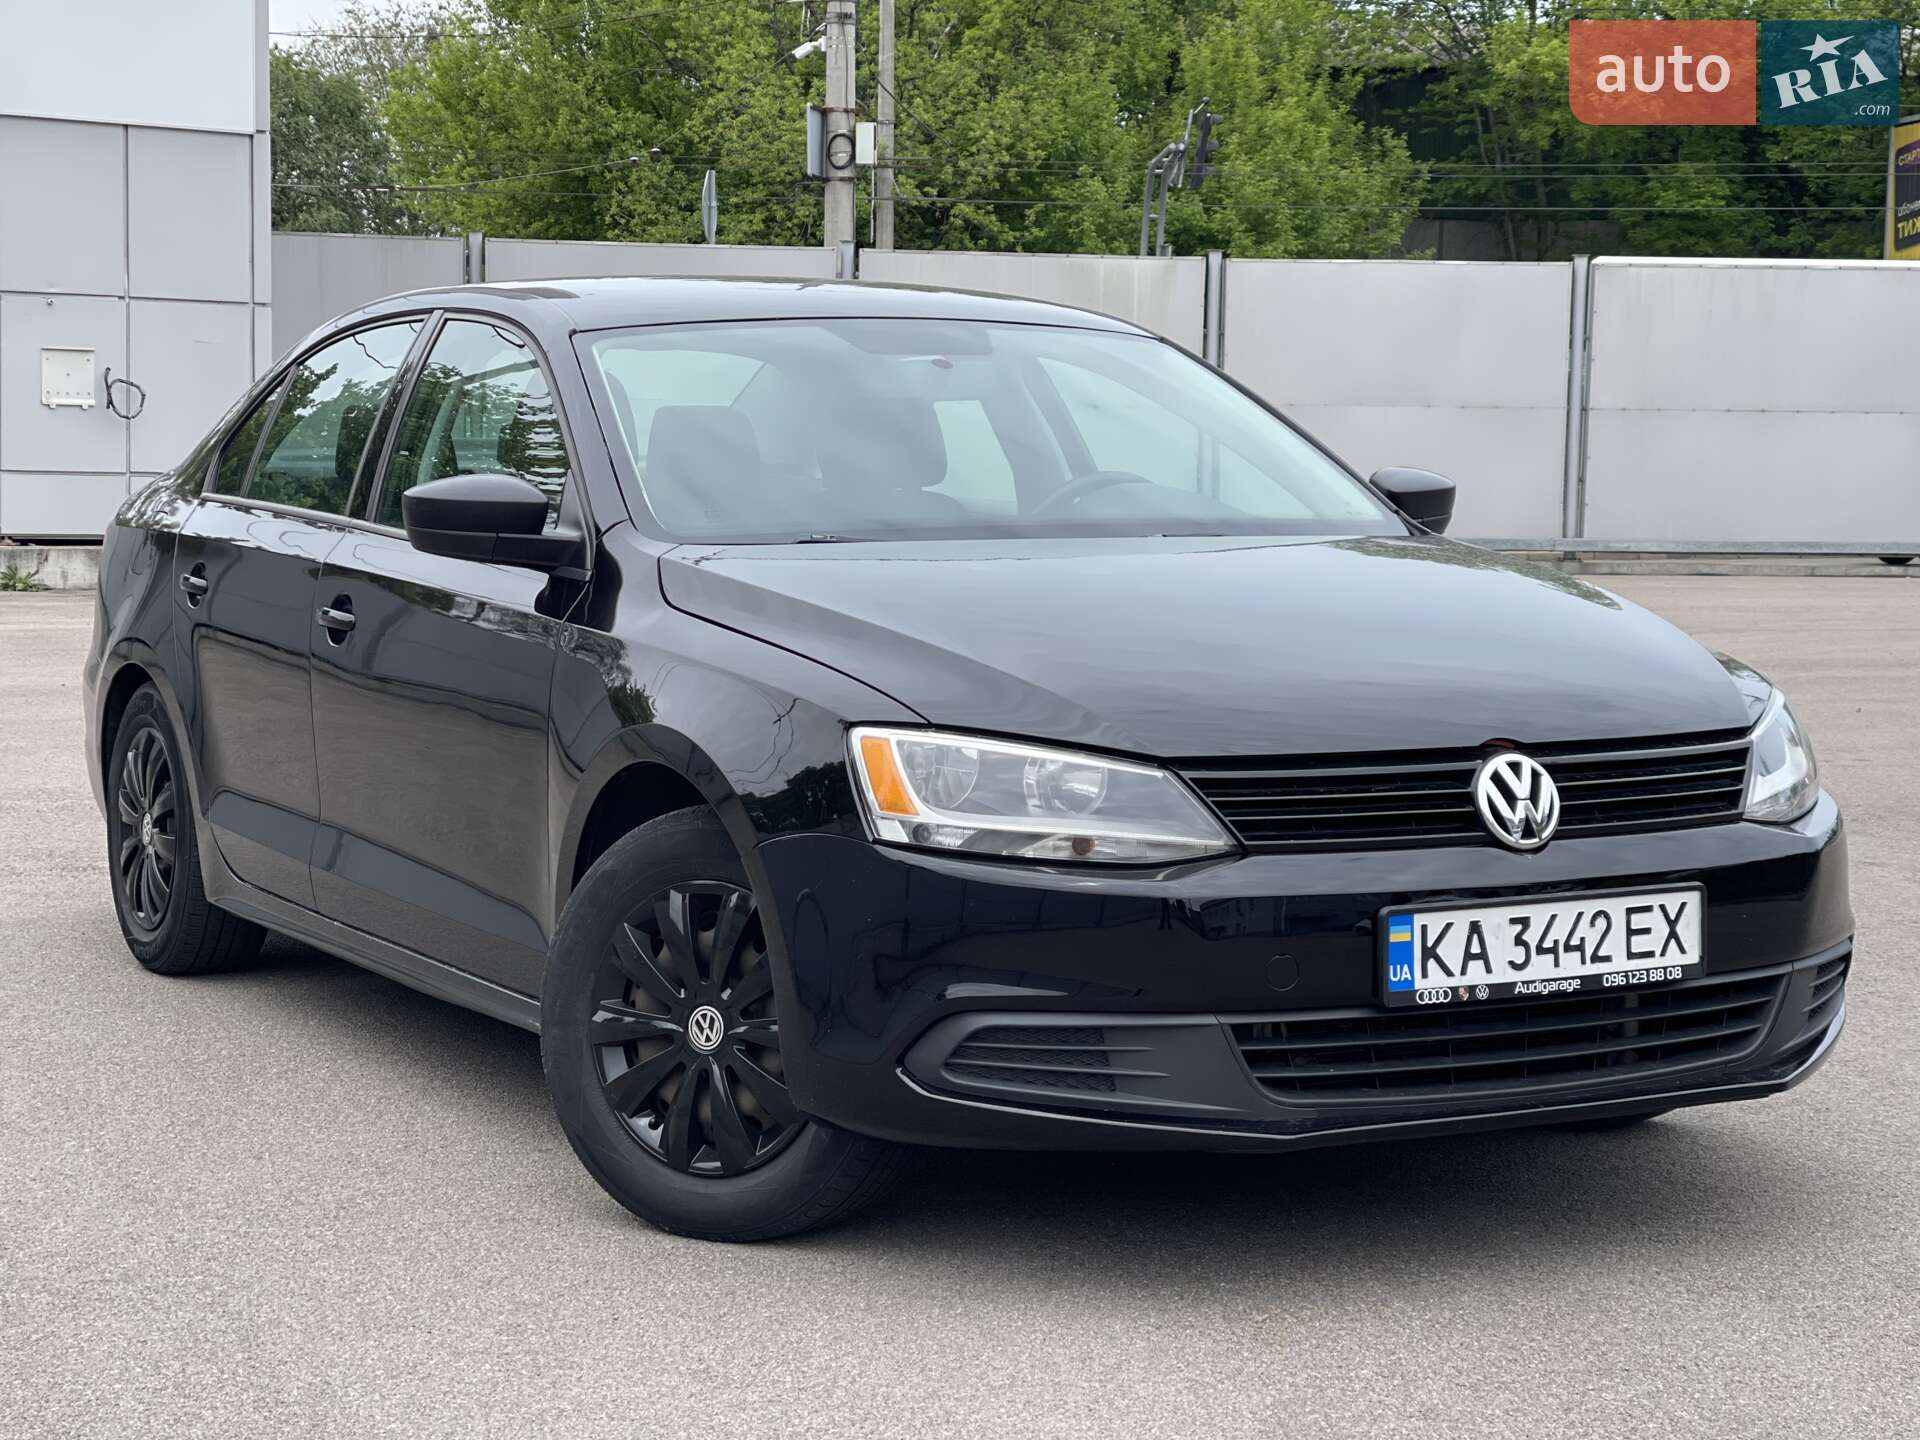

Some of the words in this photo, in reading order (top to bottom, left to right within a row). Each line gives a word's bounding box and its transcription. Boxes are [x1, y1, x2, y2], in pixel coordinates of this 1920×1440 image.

[1420, 920, 1493, 979] KA
[1507, 909, 1613, 971] 3442
[1625, 901, 1688, 961] EX
[1389, 964, 1412, 982] UA
[1514, 978, 1581, 995] Audigarage
[1603, 972, 1627, 987] 096
[1628, 970, 1647, 984] 123
[1649, 968, 1665, 982] 88
[1666, 966, 1682, 980] 08
